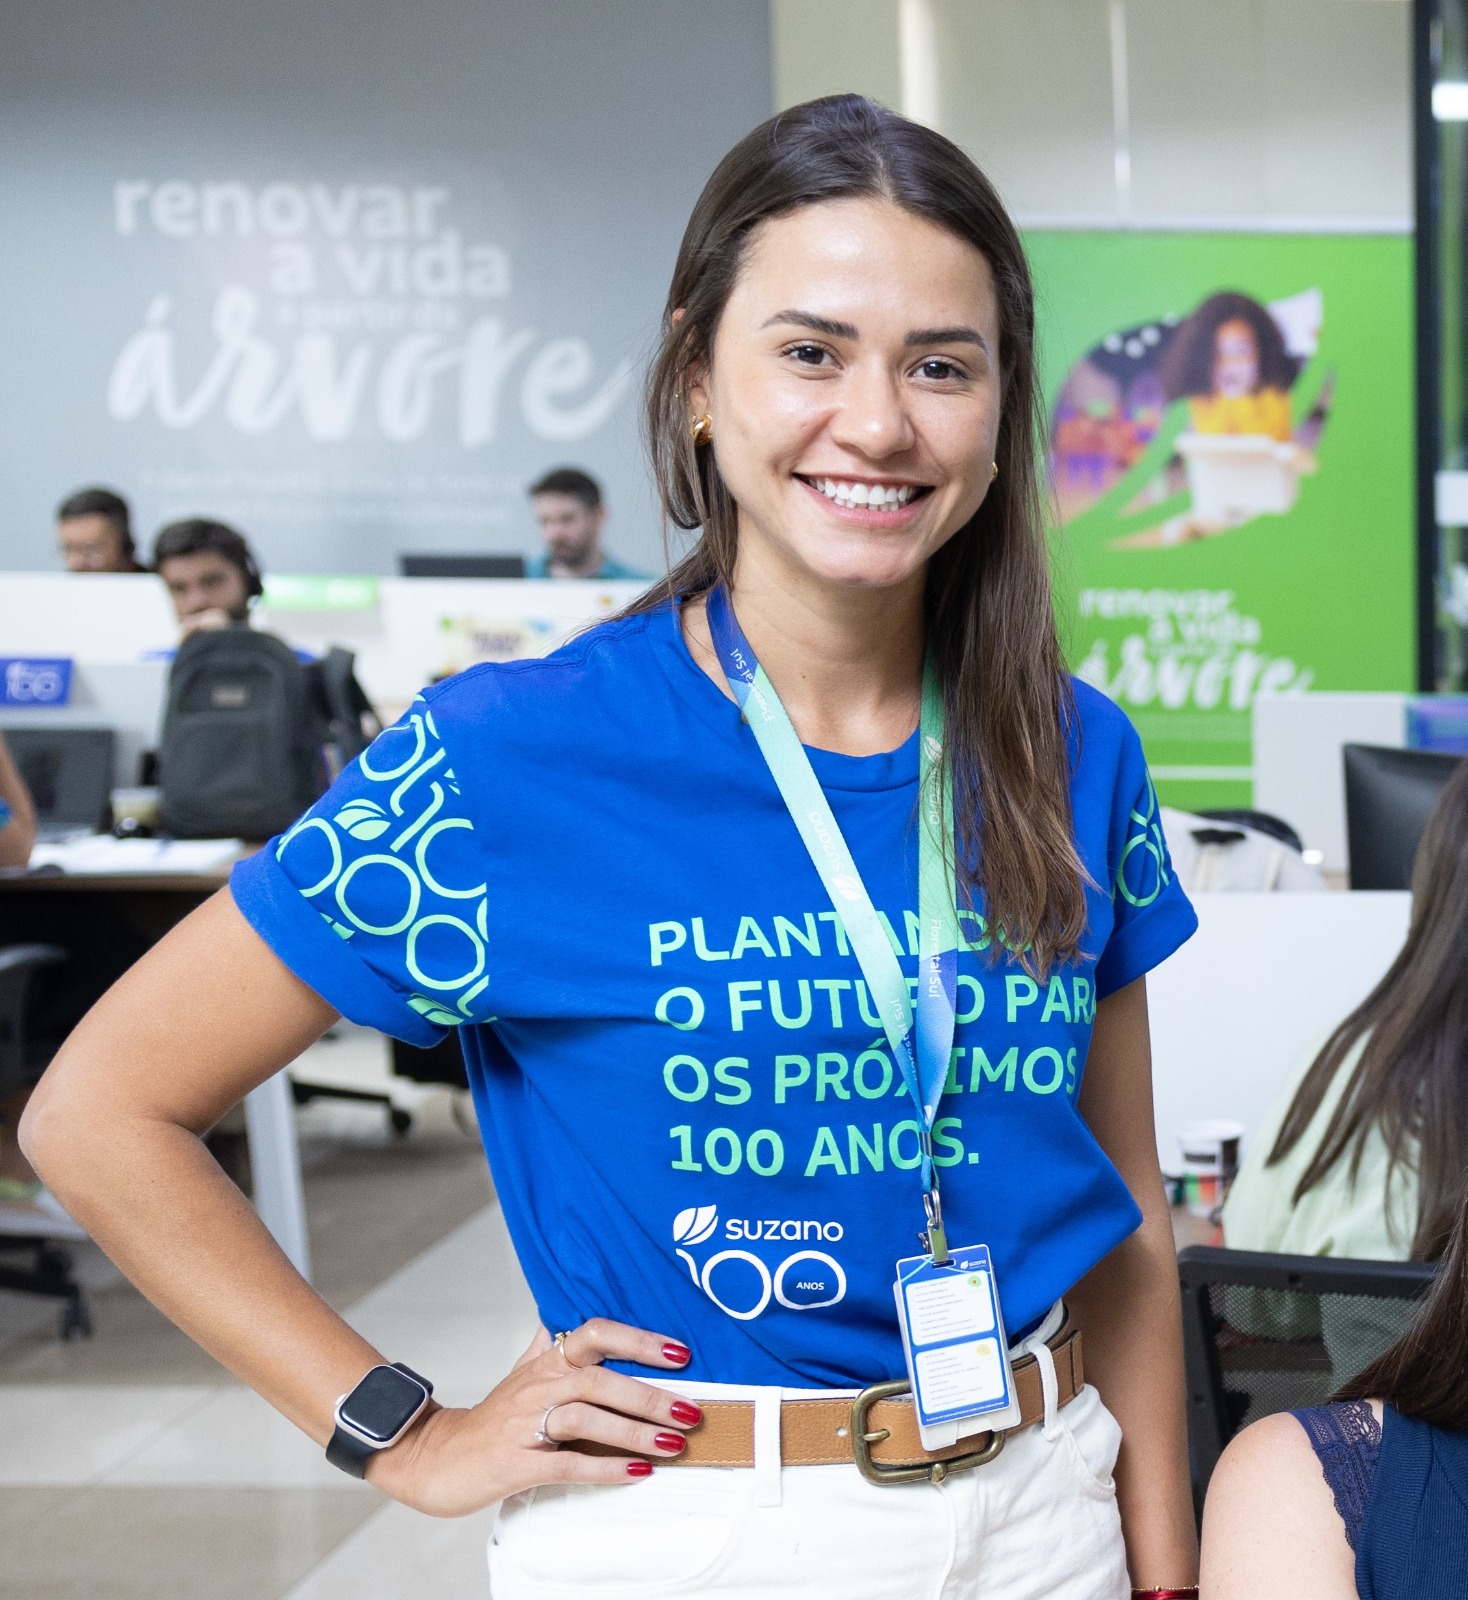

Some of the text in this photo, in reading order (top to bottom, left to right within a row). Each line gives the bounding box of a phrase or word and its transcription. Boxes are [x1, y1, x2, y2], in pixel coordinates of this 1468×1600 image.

[113, 180, 449, 236] renovar
[269, 227, 512, 297] a vida
[107, 284, 631, 447] árvore
[1081, 589, 1235, 618] renovar
[730, 648, 747, 670] Sul
[808, 811, 845, 872] suzano
[928, 917, 943, 999] Florestal Sul
[654, 986, 705, 1032] O
[1004, 974, 1097, 1025] PAR
[662, 1037, 1077, 1106] OS PRÓIMOS
[669, 1116, 980, 1177] 100 ANOS.
[725, 1218, 844, 1242] suzano
[796, 1281, 825, 1291] ANOS
